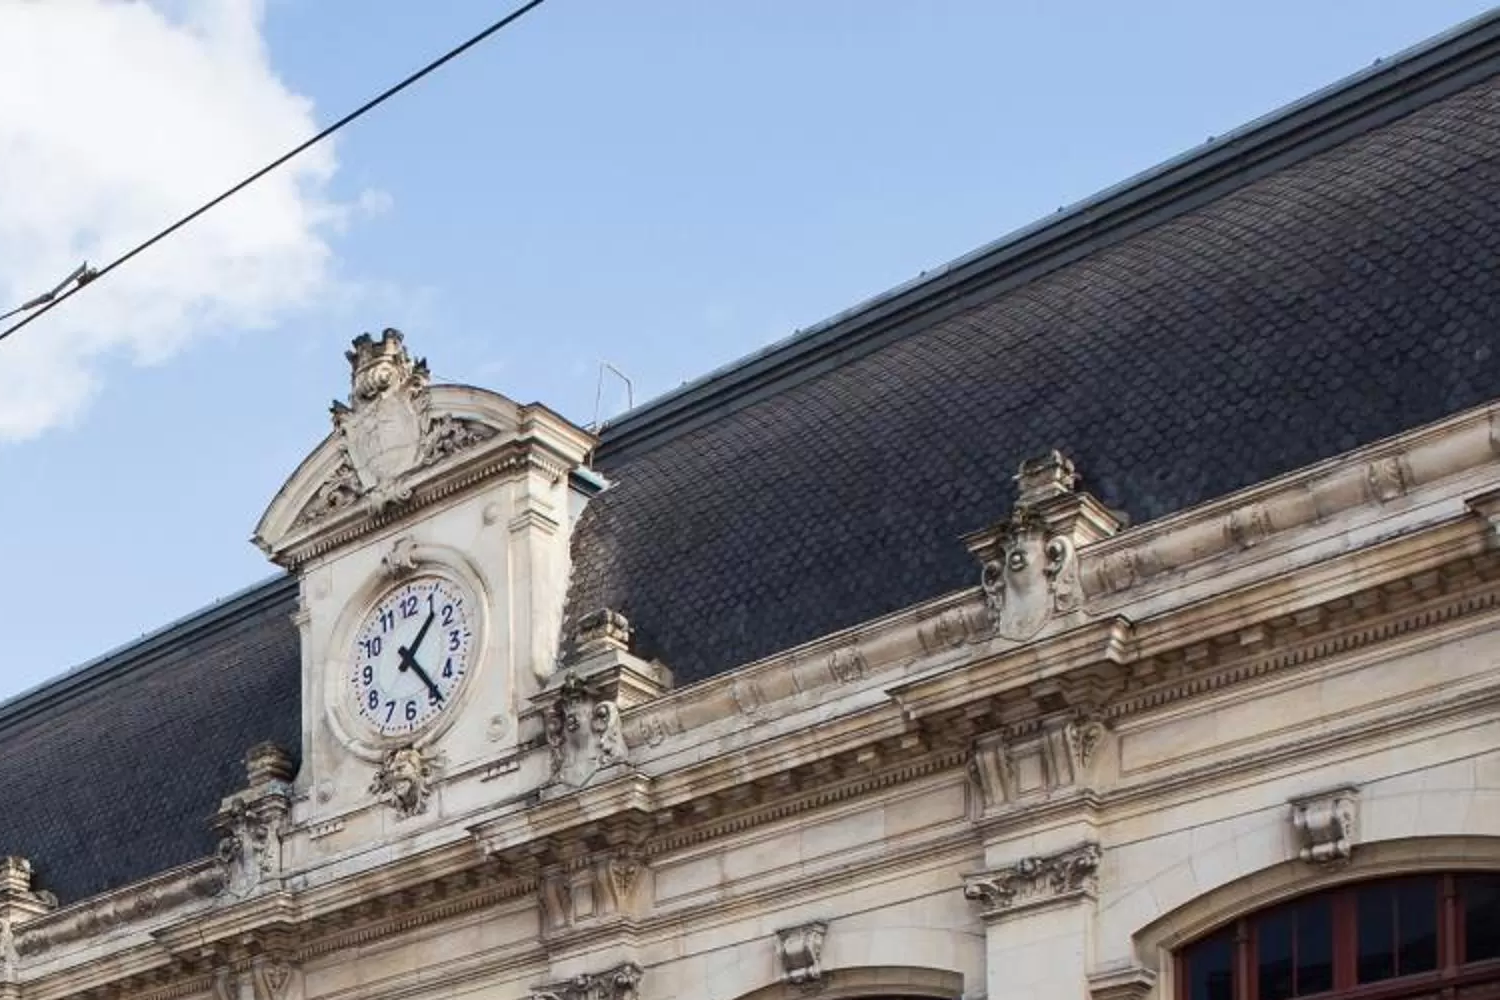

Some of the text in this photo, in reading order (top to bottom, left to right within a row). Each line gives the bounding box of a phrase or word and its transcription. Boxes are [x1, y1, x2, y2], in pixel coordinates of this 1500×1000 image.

[399, 595, 419, 619] 12
[441, 605, 454, 626] 2
[380, 610, 394, 633] 11
[364, 636, 381, 659] 10
[449, 630, 460, 651] 3
[363, 665, 373, 686] 9
[442, 658, 453, 678] 4
[368, 689, 379, 710] 8
[385, 700, 396, 723] 7
[405, 700, 417, 721] 6
